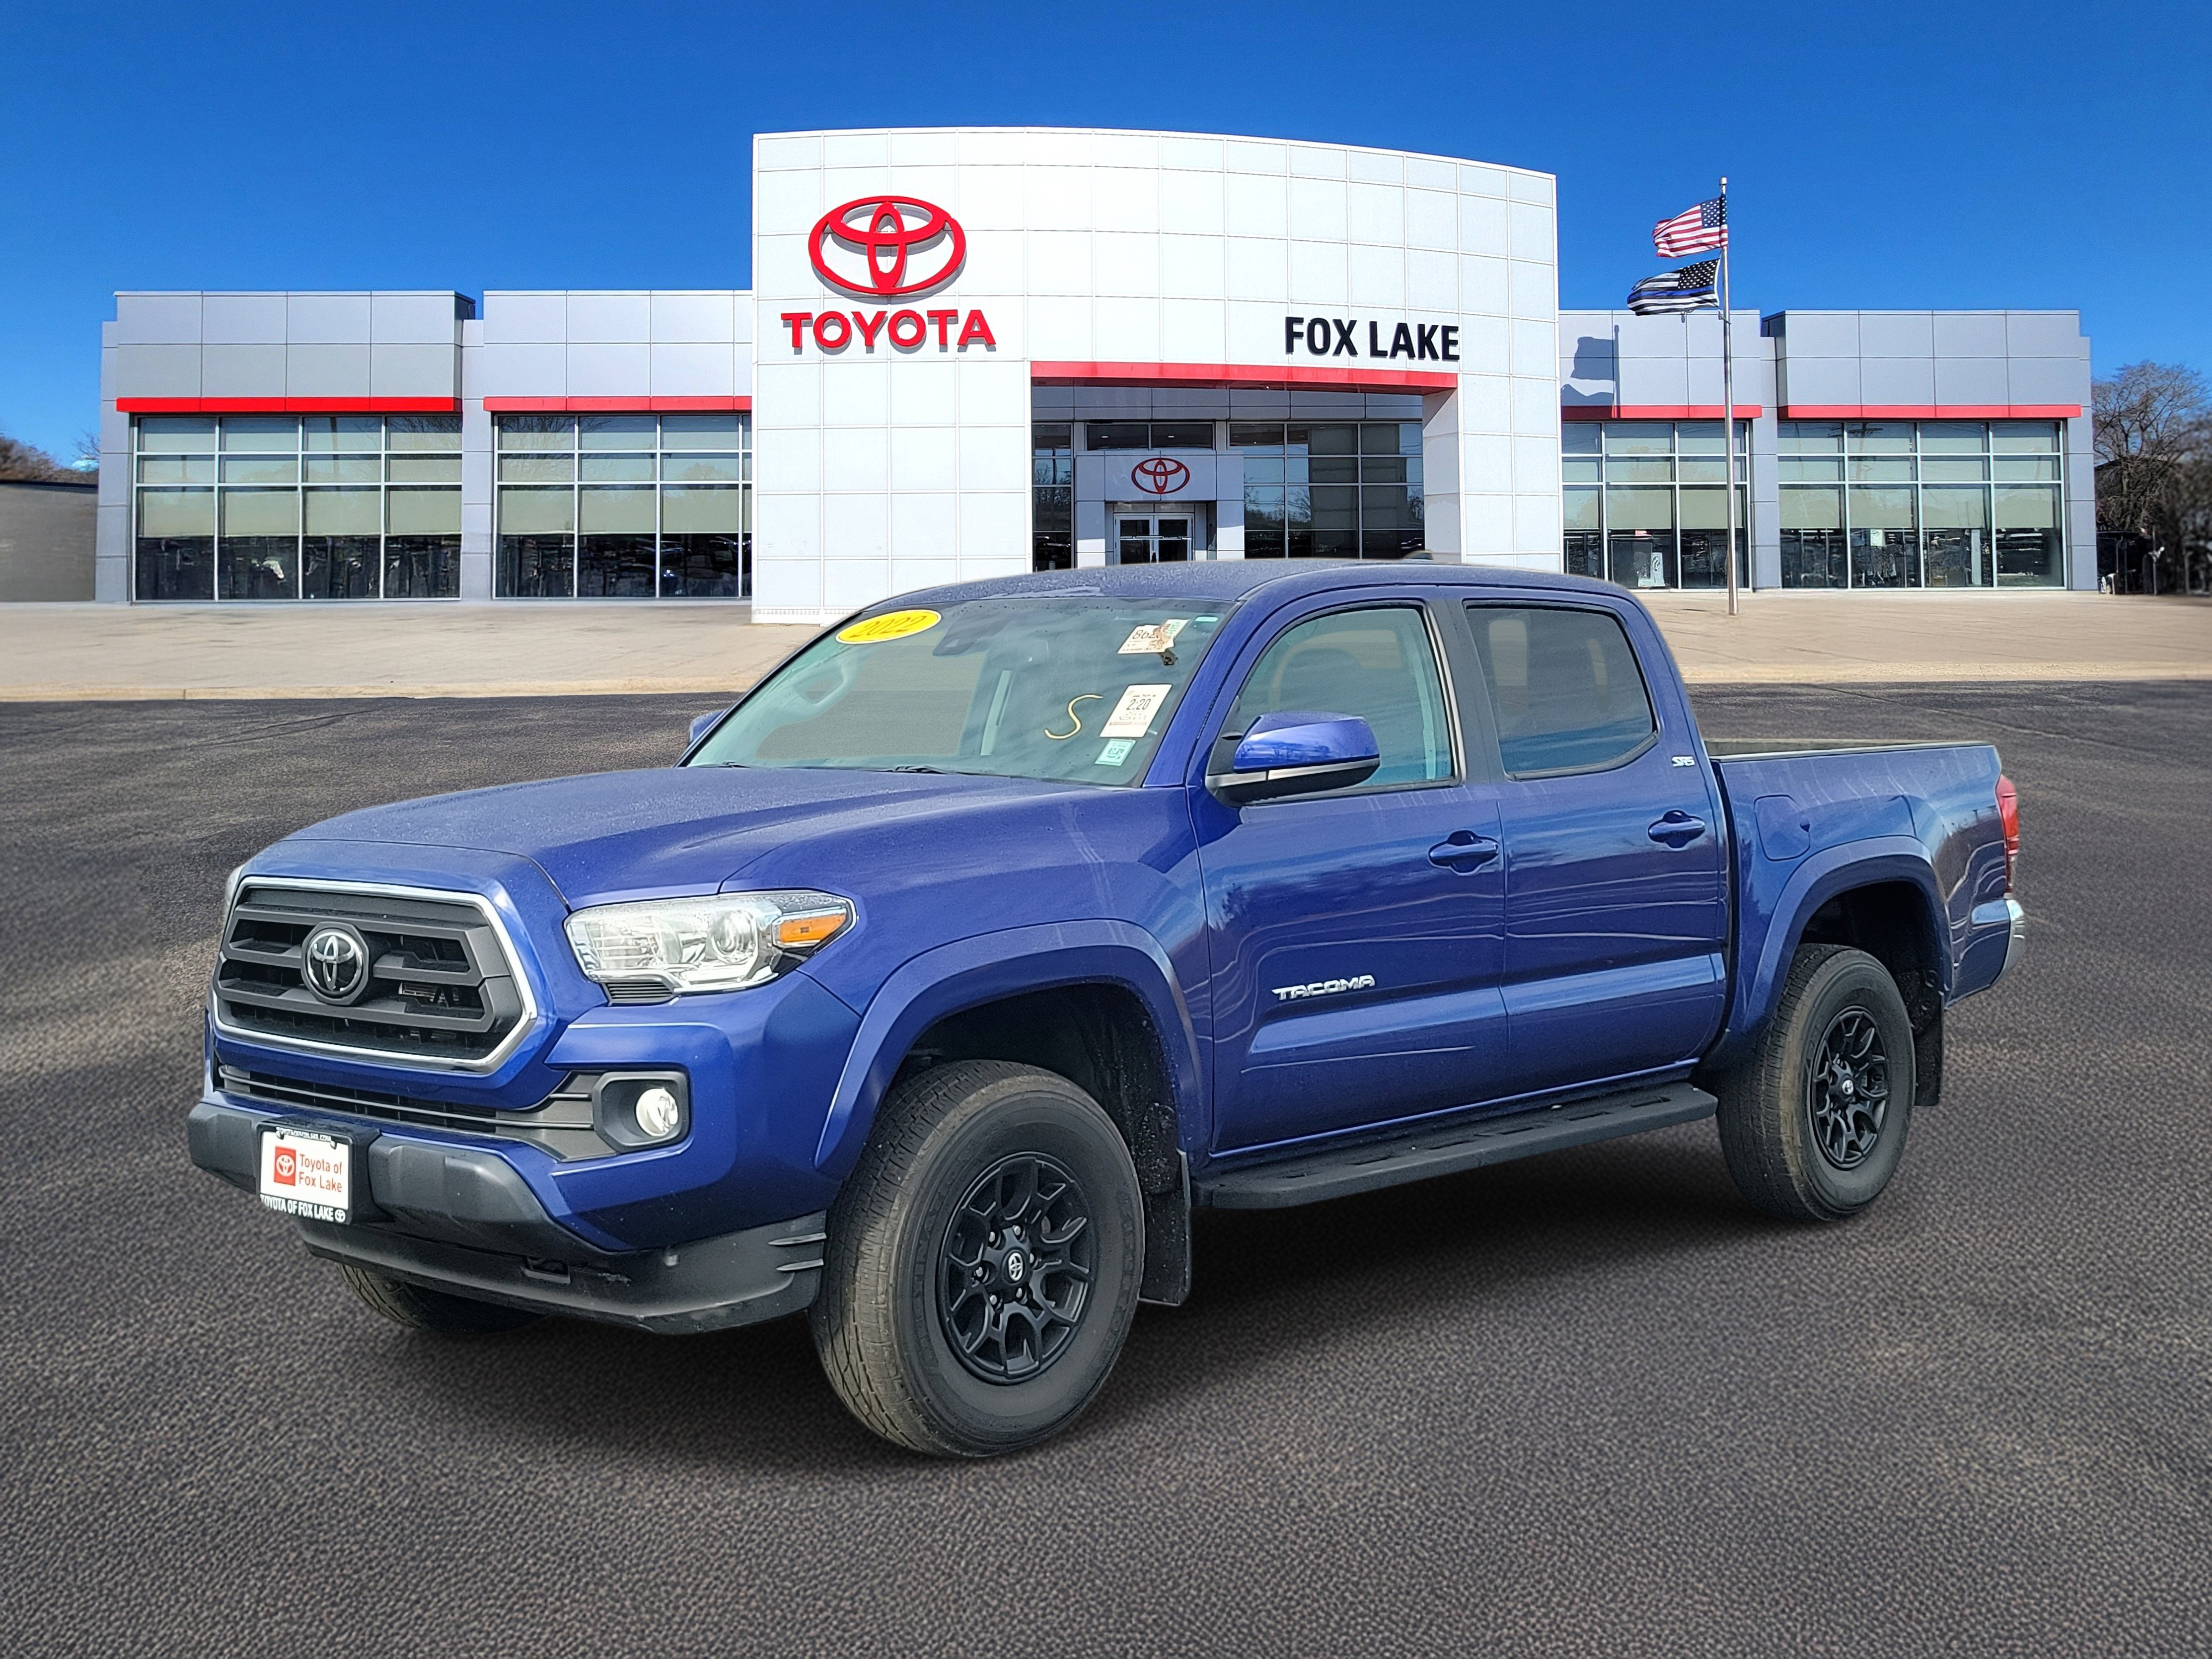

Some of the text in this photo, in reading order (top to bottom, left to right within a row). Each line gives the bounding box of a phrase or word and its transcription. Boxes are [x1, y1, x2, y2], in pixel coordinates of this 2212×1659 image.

[781, 309, 996, 350] TOYOTA
[1285, 316, 1460, 361] FOX LAKE
[849, 615, 927, 638] 2022
[1044, 694, 1104, 740] S
[1271, 974, 1375, 1001] TACOMA
[299, 1154, 342, 1174] Toyota of
[299, 1171, 342, 1193] Fox Lake
[260, 1194, 334, 1222] TOYOTA OF FOX LAKE
